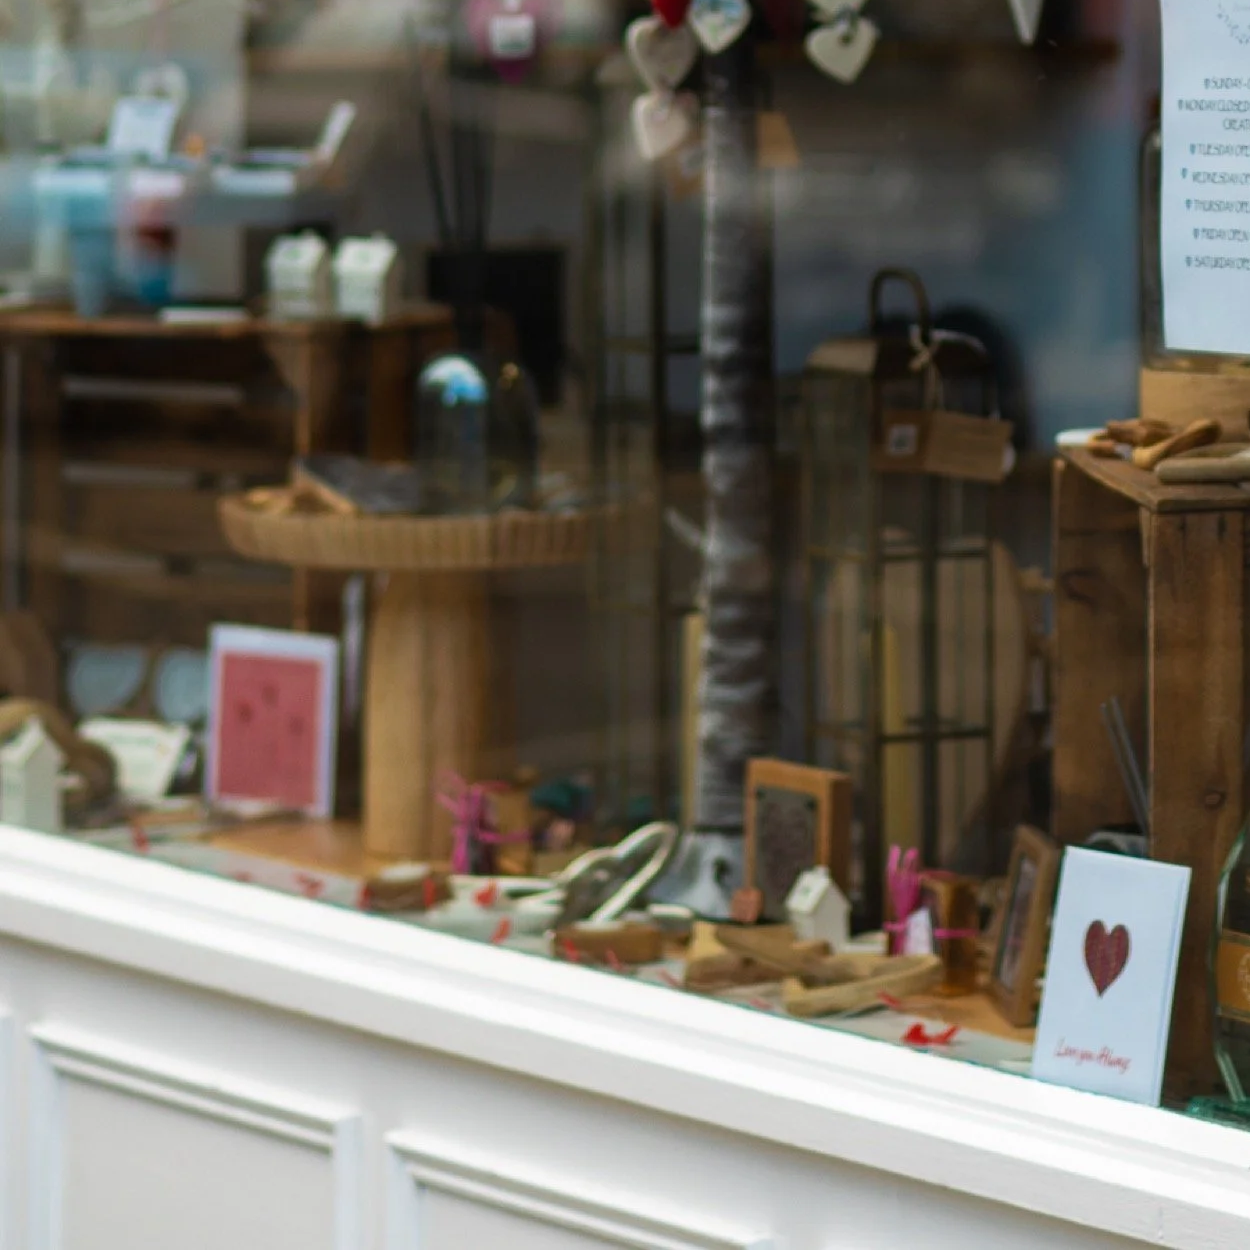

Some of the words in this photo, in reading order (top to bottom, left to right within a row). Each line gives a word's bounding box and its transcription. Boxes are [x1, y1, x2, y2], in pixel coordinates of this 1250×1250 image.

[1198, 143, 1234, 155] TUESDAY
[1192, 171, 1239, 184] WEDNESDAY
[1194, 199, 1234, 212] THURSDAY
[1201, 228, 1226, 240] FRIDAY
